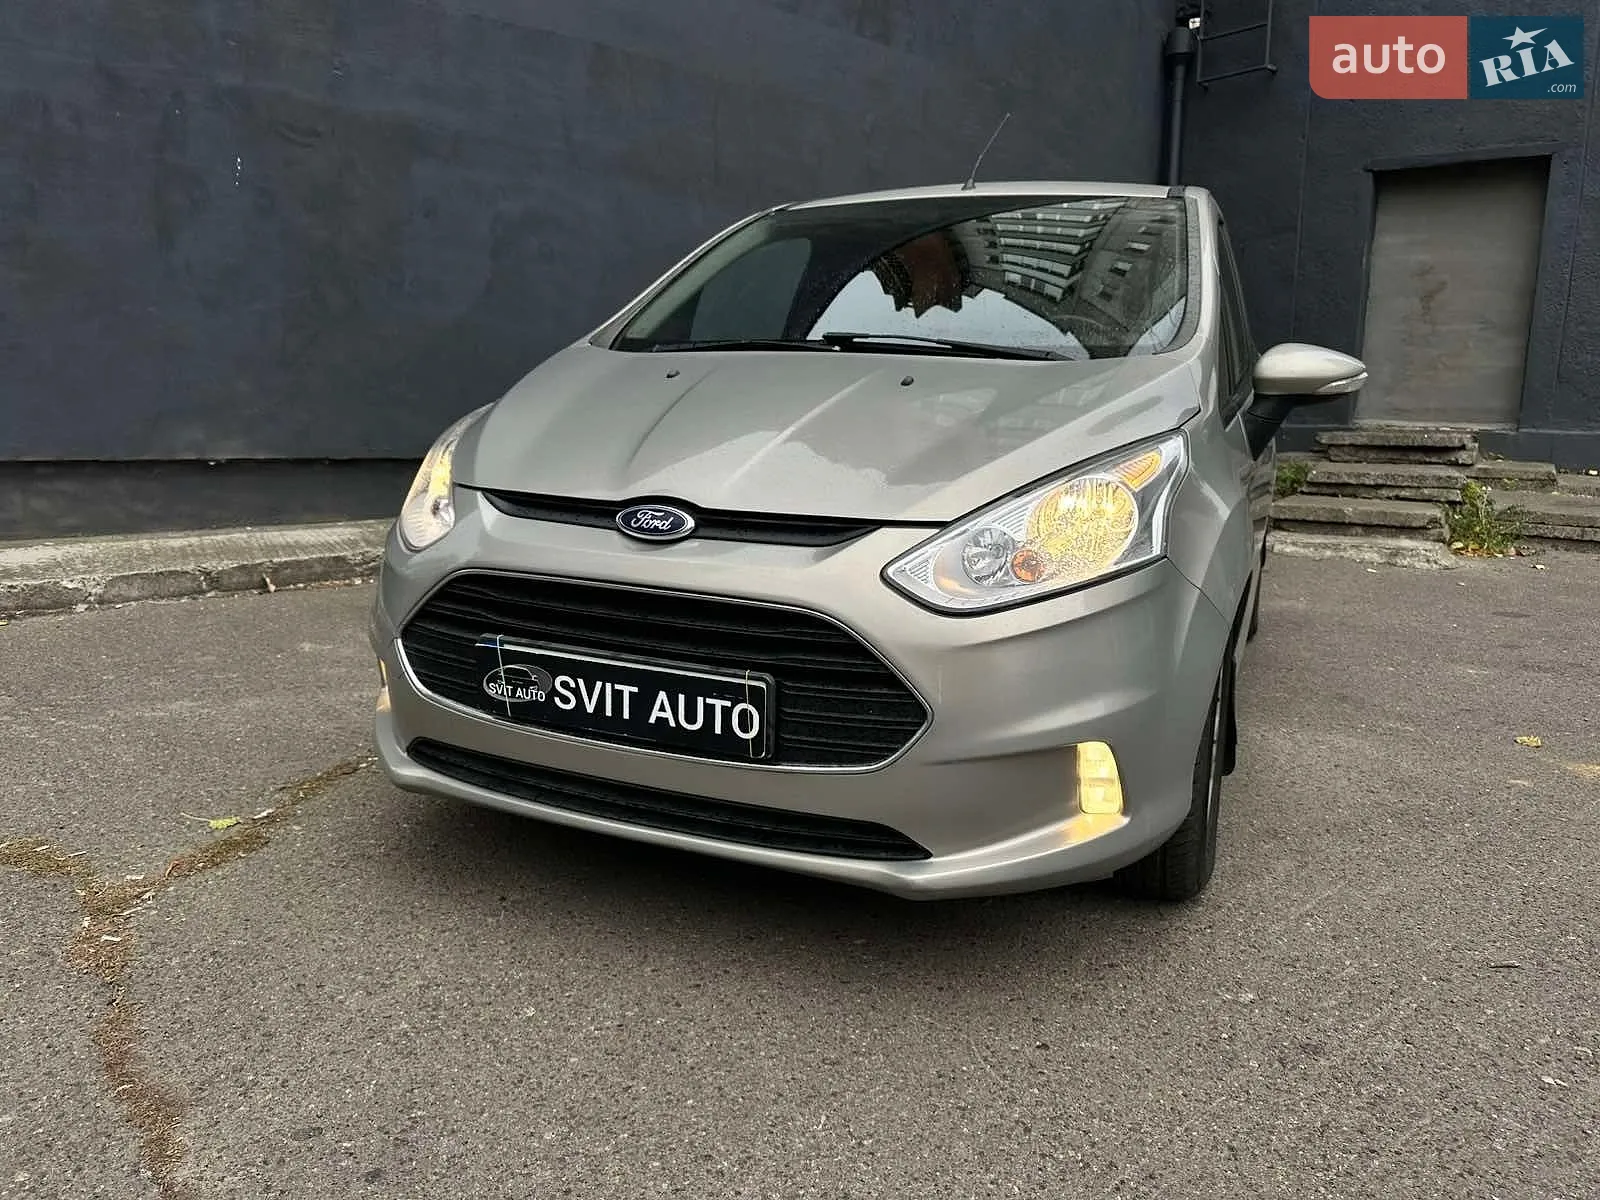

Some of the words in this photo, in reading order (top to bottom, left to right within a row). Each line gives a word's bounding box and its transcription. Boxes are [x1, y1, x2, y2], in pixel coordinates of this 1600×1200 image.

[631, 510, 674, 530] Ford
[488, 682, 514, 698] SVIT
[515, 687, 546, 702] AUTO
[554, 675, 639, 720] SVIT
[648, 690, 760, 739] AUTO
